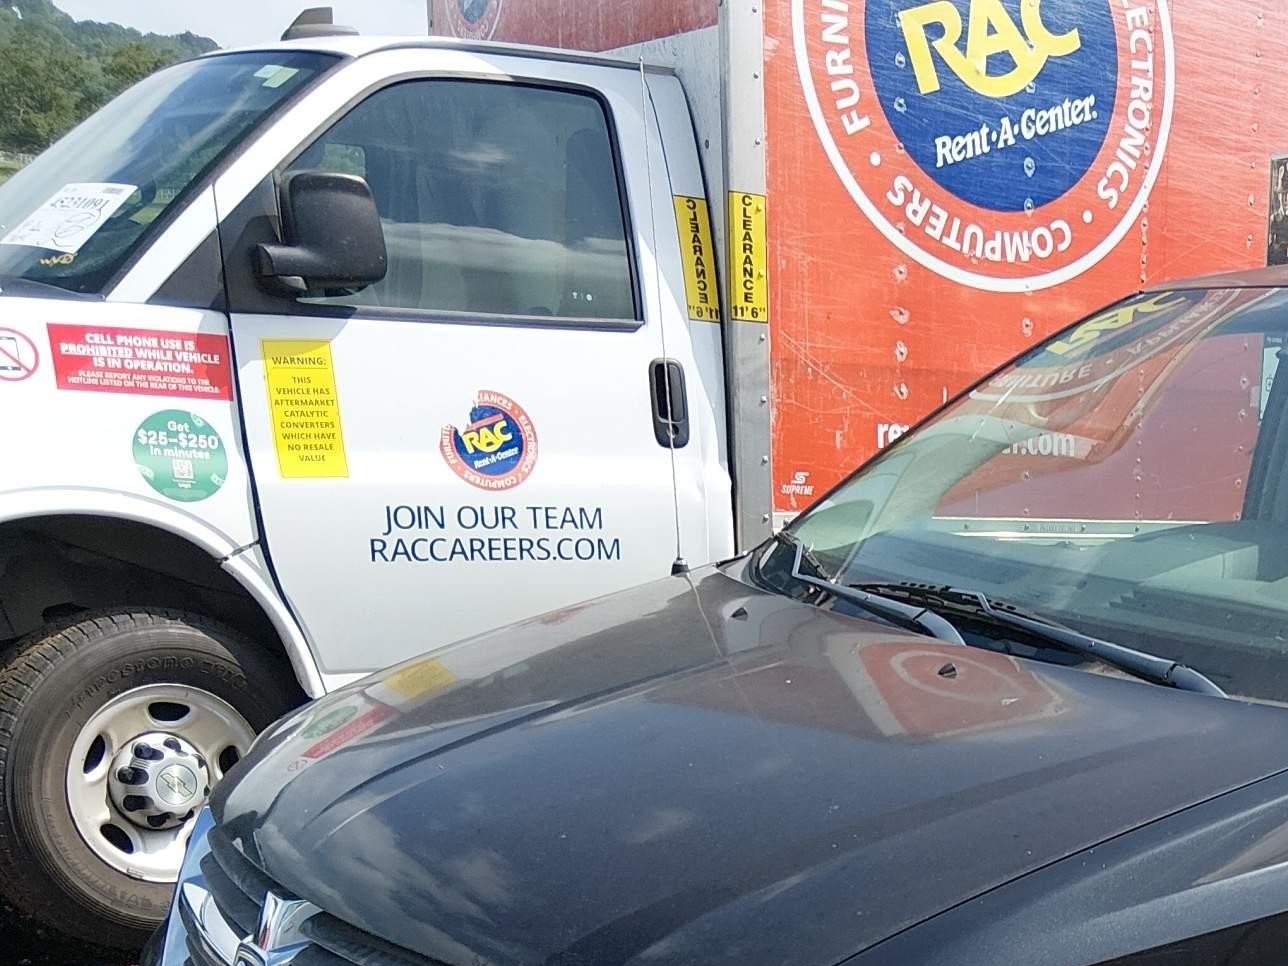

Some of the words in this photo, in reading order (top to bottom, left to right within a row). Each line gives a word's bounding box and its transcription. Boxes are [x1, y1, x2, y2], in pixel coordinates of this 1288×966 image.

[897, 0, 1081, 97] RAC
[1097, 0, 1153, 209] ECTRONICS
[886, 175, 1072, 263] COMPUTERS
[741, 195, 754, 303] CLEARANCE
[86, 333, 114, 345] CELL
[116, 335, 159, 348] PHONE
[161, 337, 182, 350] USE
[184, 340, 196, 351] IS
[60, 342, 133, 357] PROHIBITED
[136, 348, 174, 361] WHILE
[175, 351, 220, 365] VEHICLE
[94, 357, 105, 368] IS
[108, 358, 122, 369] IN
[125, 359, 194, 374] OPERATION.
[272, 356, 327, 366] WARNING:
[78, 370, 104, 378] PLEASE
[104, 371, 132, 380] REPORT
[132, 373, 147, 382] ANY
[187, 377, 198, 385] TO
[101, 378, 123, 387] LISTED
[123, 380, 135, 388] ON
[136, 381, 150, 390] THE
[292, 376, 312, 384] THIS
[276, 387, 311, 395] VEHICLE
[312, 387, 330, 395] HAS
[274, 399, 335, 407] AFTERMARKET
[284, 410, 329, 418] CATALYTIC
[167, 420, 190, 433] Get
[280, 421, 335, 429] CONVERTERS
[281, 432, 312, 440] WHICH
[313, 432, 336, 440] HAVE
[461, 420, 513, 454] RAC
[163, 446, 212, 460] minutes
[287, 443, 302, 451] NO
[303, 443, 334, 451] RESALE
[781, 484, 814, 496] SUPREME
[382, 505, 445, 536] JOIN
[457, 505, 519, 530] OUR
[526, 506, 603, 530] TEAM
[370, 537, 621, 562] RACCAREERS.COM
